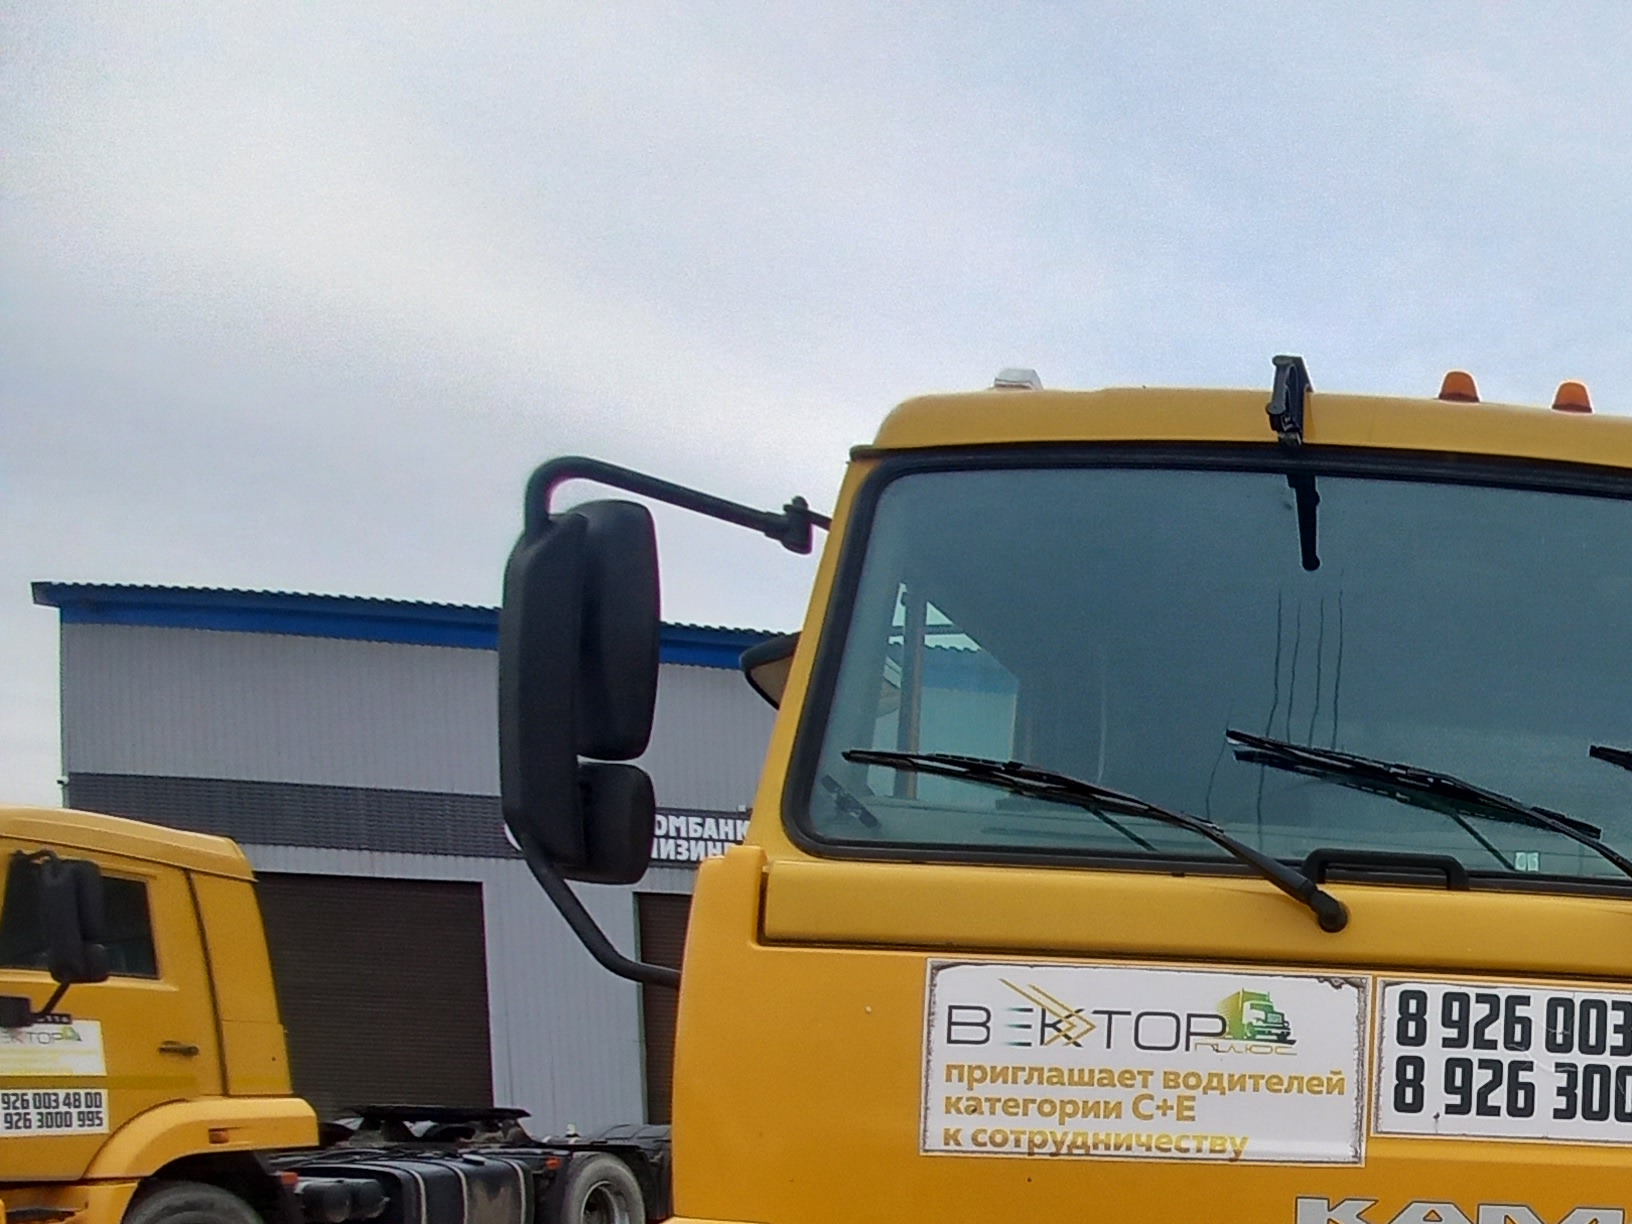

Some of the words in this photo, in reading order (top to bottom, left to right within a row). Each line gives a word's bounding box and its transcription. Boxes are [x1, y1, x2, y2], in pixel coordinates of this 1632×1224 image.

[655, 814, 750, 841] ОМБАНК
[946, 1005, 1228, 1052] ВЕКТОР
[1396, 990, 1427, 1047] 8
[1441, 992, 1533, 1051] 926
[944, 1062, 1154, 1091] приглашает
[1162, 1070, 1346, 1096] водителей
[1394, 1055, 1425, 1113] 8
[1444, 1058, 1535, 1118] 926
[1, 1093, 30, 1110] 926
[32, 1092, 60, 1109] 003
[62, 1092, 82, 1109] 48
[84, 1092, 103, 1109] 00
[944, 1093, 1124, 1125] категории
[4, 1112, 32, 1130] 926
[36, 1111, 73, 1128] 3000
[77, 1110, 104, 1128] 995
[943, 1126, 962, 1147] к
[970, 1126, 1249, 1161] сотрудничеству
